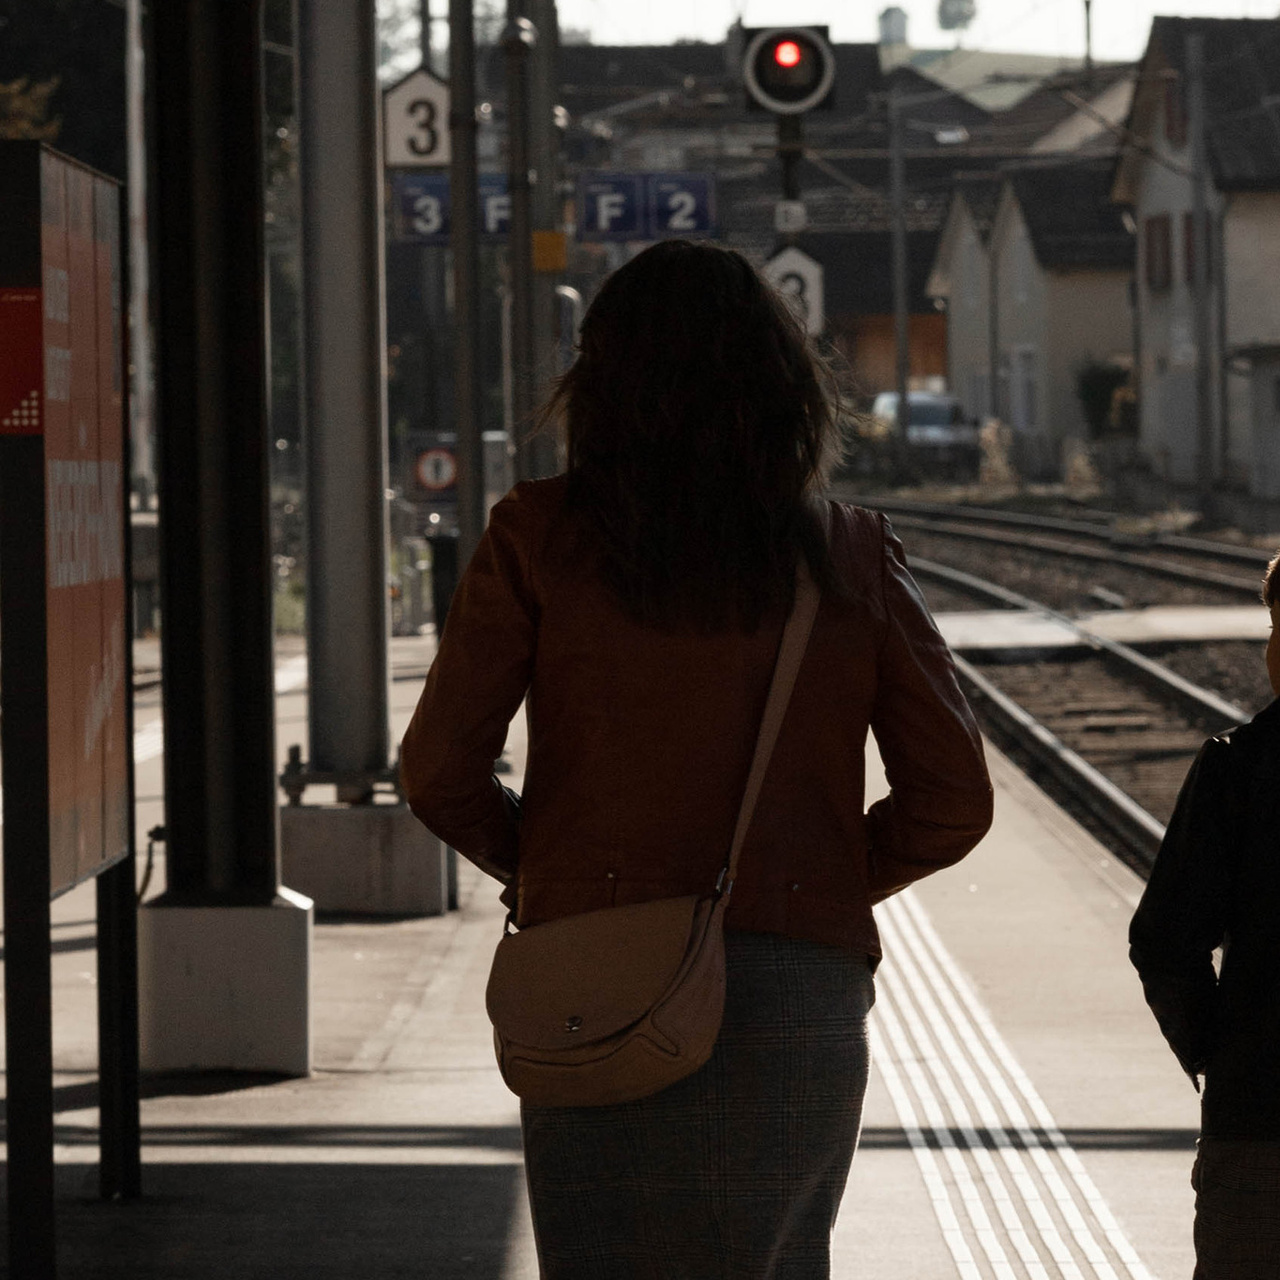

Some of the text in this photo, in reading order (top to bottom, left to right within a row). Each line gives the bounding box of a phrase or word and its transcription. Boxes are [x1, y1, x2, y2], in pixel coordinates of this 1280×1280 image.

[406, 98, 440, 158] 3
[413, 193, 511, 234] 3 F
[598, 191, 697, 231] F 2
